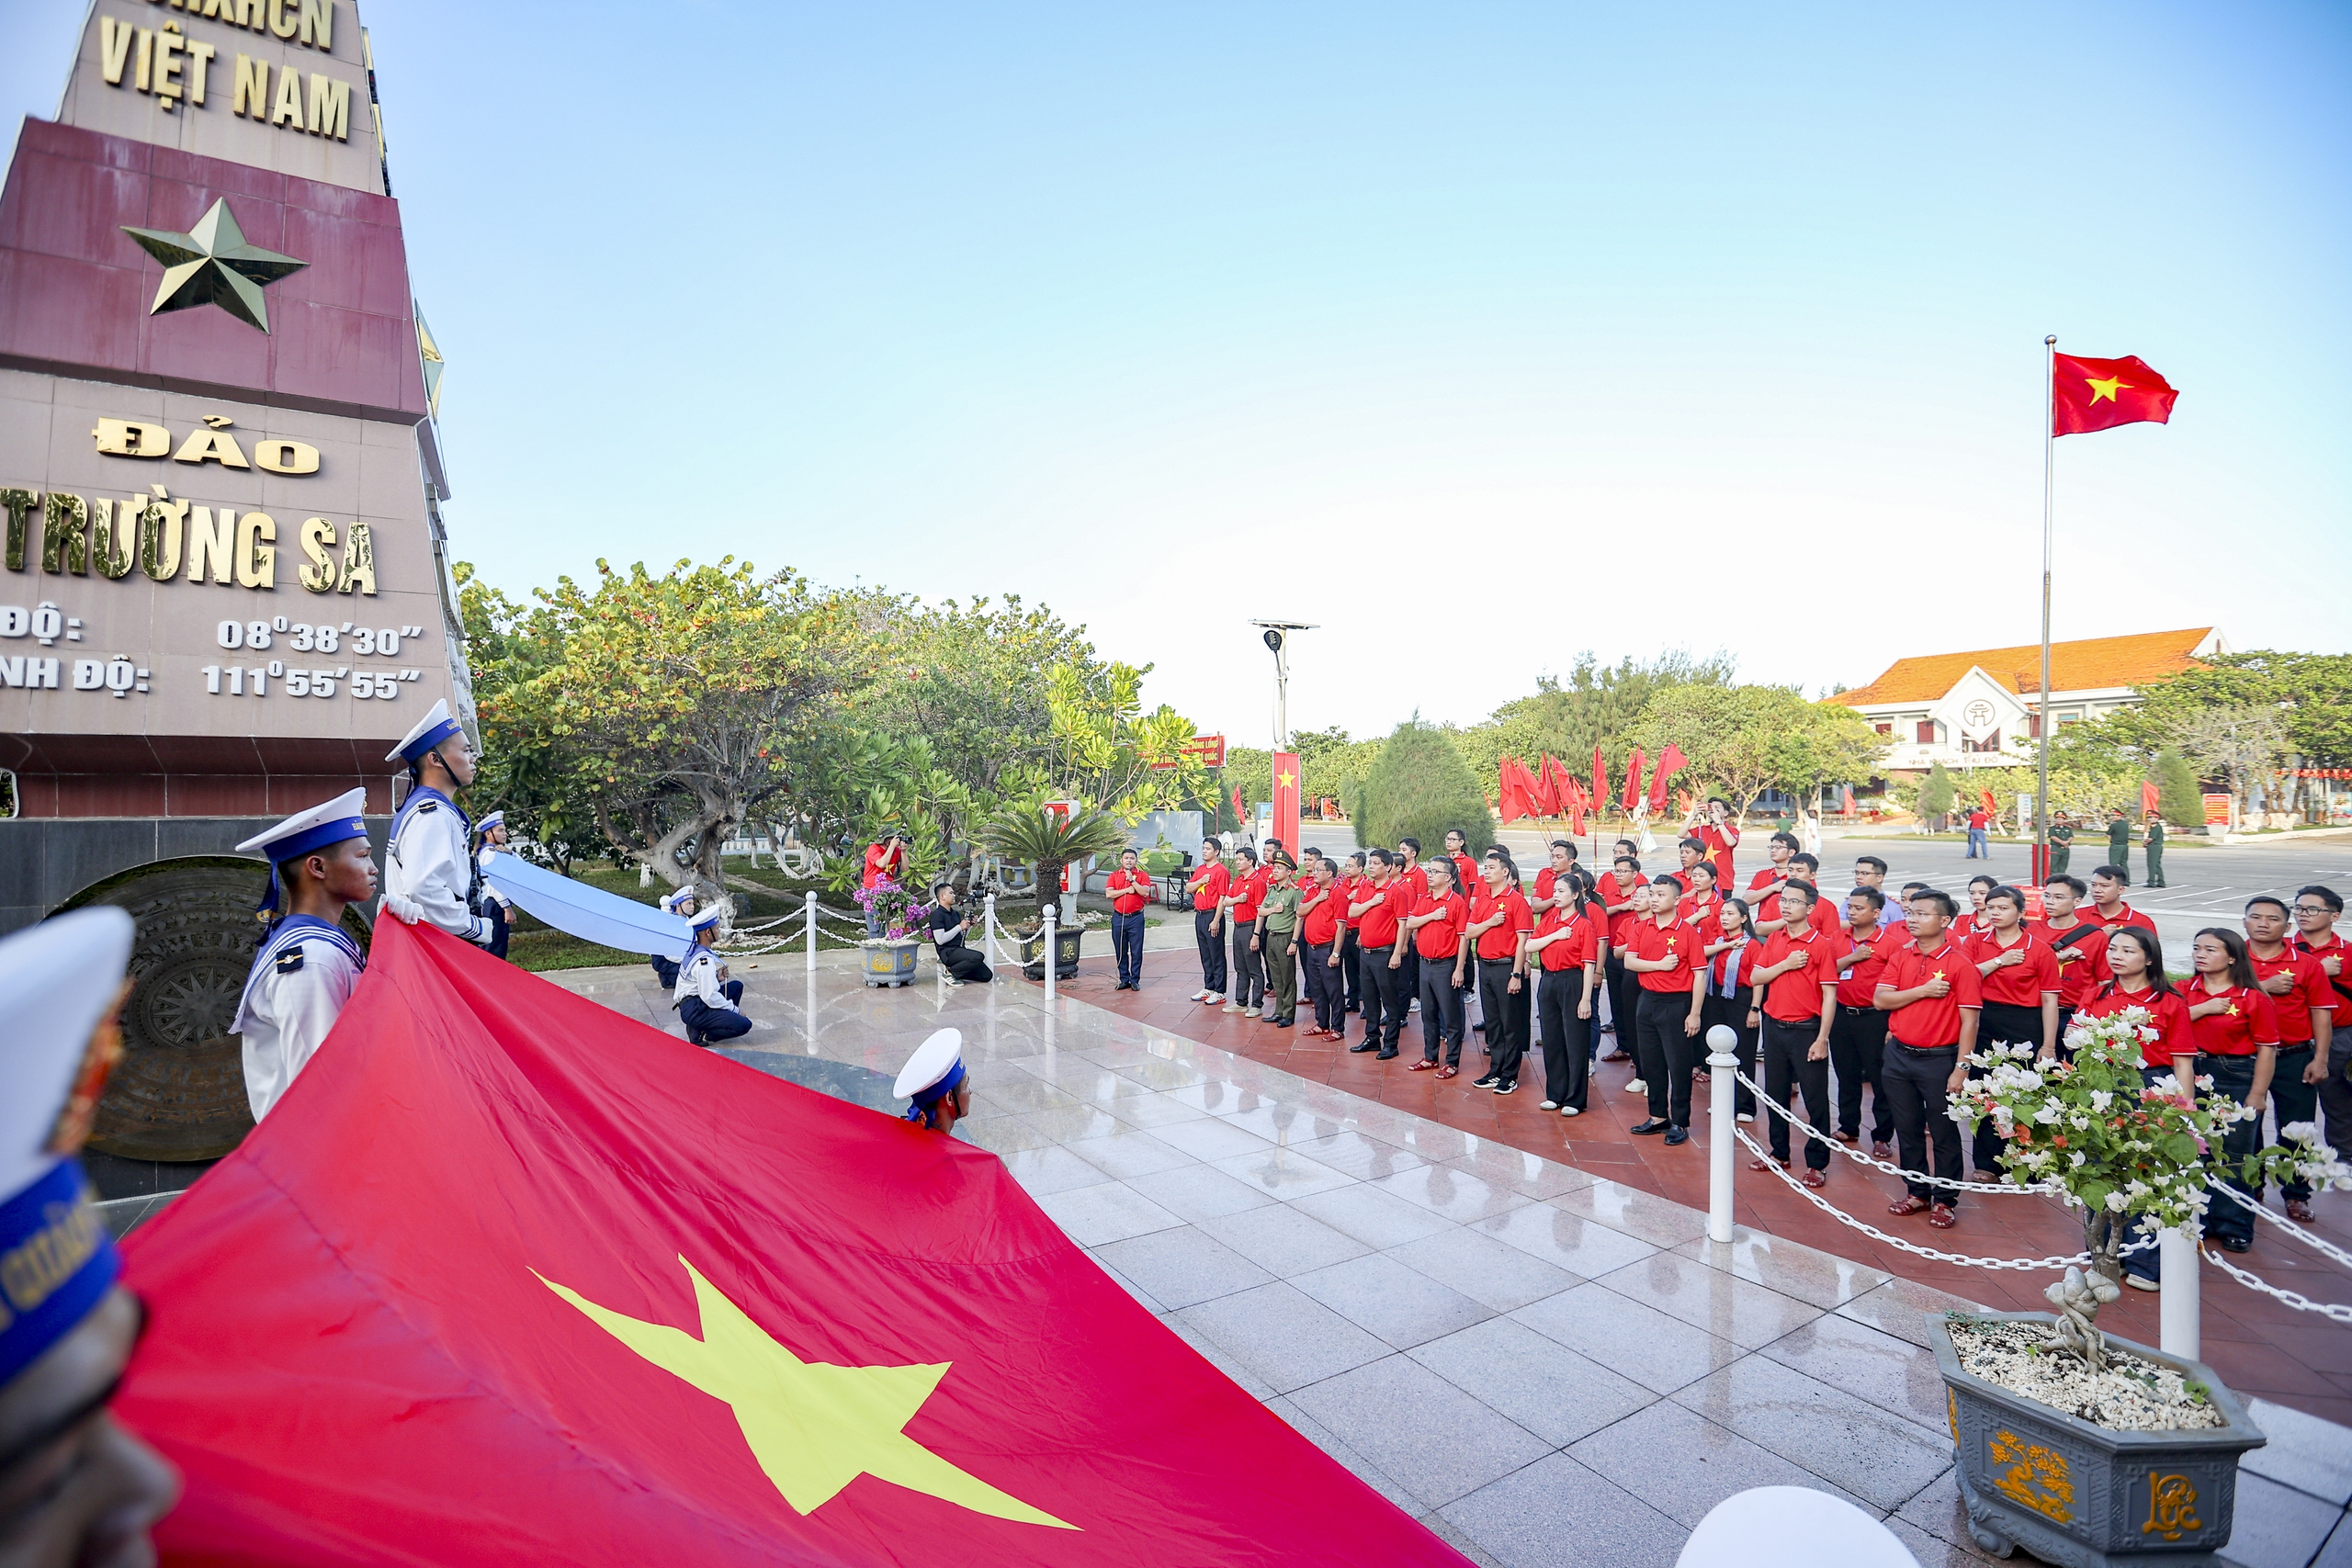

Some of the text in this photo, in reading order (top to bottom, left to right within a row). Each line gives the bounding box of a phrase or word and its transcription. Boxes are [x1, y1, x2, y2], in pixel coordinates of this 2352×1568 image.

[100, 15, 350, 143] VIỆT NAM
[92, 414, 321, 475] ĐẢO
[0, 484, 379, 595] TRƯỜNG SA
[0, 601, 82, 646] ĐỘ:
[73, 653, 151, 698] ĐỘ:
